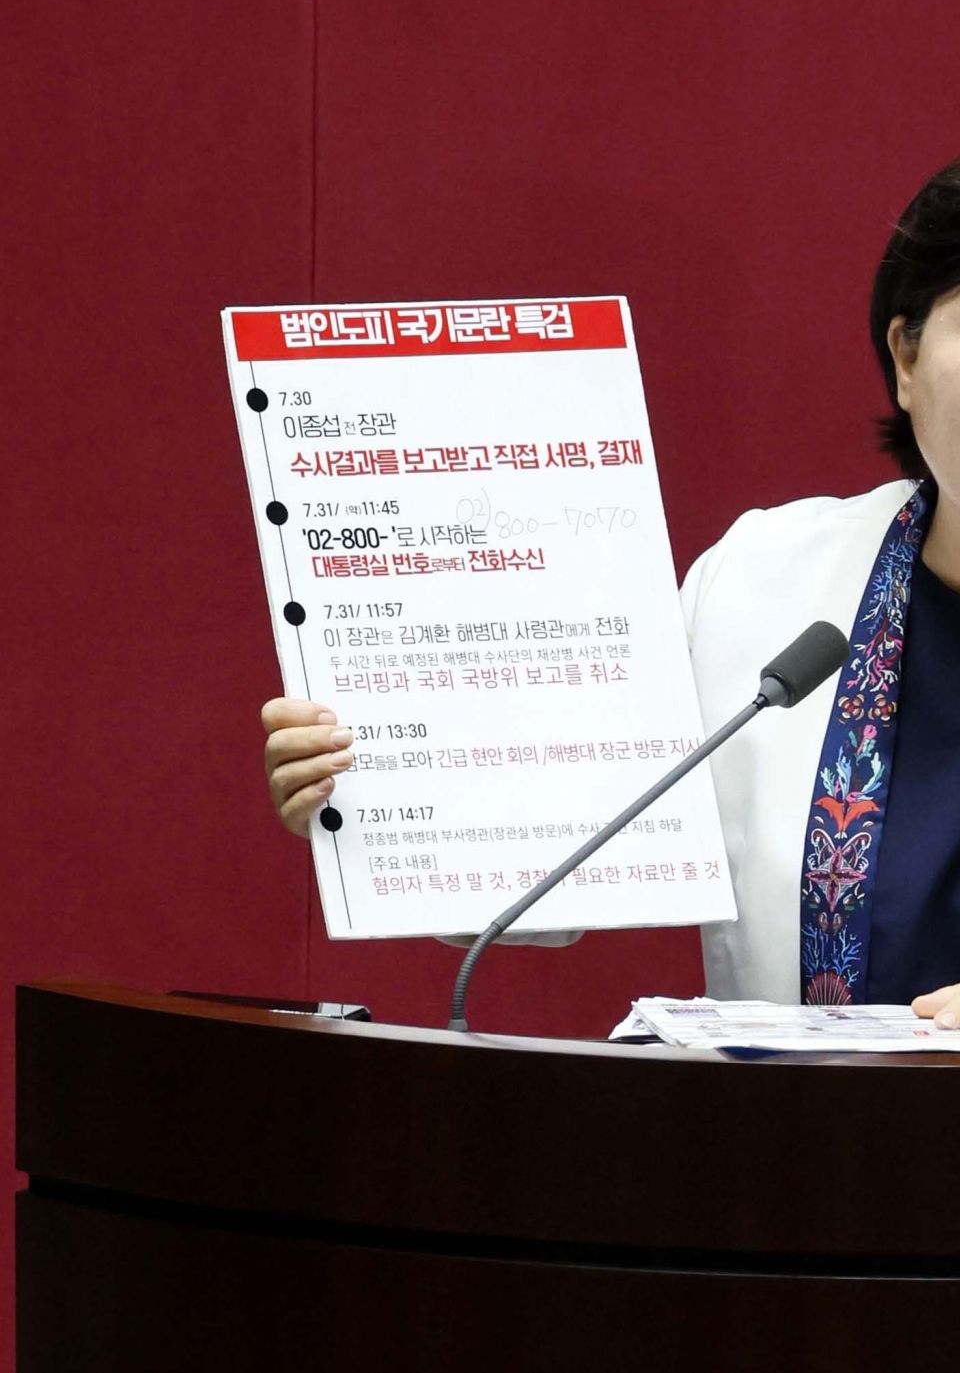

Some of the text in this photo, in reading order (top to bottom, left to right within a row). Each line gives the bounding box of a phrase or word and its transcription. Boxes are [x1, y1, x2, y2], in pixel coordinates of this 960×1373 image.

[280, 304, 575, 348] 범인도피 국기문란 특검
[278, 391, 312, 407] 7.30
[283, 414, 341, 439] 이종섭
[357, 412, 397, 437] 장관
[290, 439, 643, 478] 수사결과를 보고받고 직접 서명, 결재
[302, 503, 339, 518] 7.31/
[419, 524, 489, 546] 시작하는
[312, 547, 546, 578] 대통령실 번호로부터 전화수신
[323, 602, 403, 620] 7.31/ 11:57
[323, 616, 630, 648] 이 장관은 김계환 해병대 사령관에게 전화
[330, 643, 632, 670] 두 시간 뒤로 예정된 해병대 수사단의 채상병 사건 언론
[334, 661, 629, 694] 브리핑과 국회 국방위 보고를 취소
[348, 723, 427, 741] .31/ 13:30
[401, 749, 433, 770] 모아
[435, 748, 468, 769] 긴급
[470, 746, 504, 768] 현안
[506, 745, 539, 766] 회의
[599, 740, 632, 762] 장군
[633, 738, 667, 760] 방문
[357, 806, 434, 824] 7.31/ 14:17
[402, 829, 439, 845] 해병대
[371, 874, 423, 896] 혐의자
[427, 872, 462, 893] 특정
[465, 870, 483, 892] 말
[571, 863, 622, 887] 필요한
[625, 862, 677, 884] 자료만
[680, 860, 699, 881] 줄
[702, 859, 721, 880] 것
